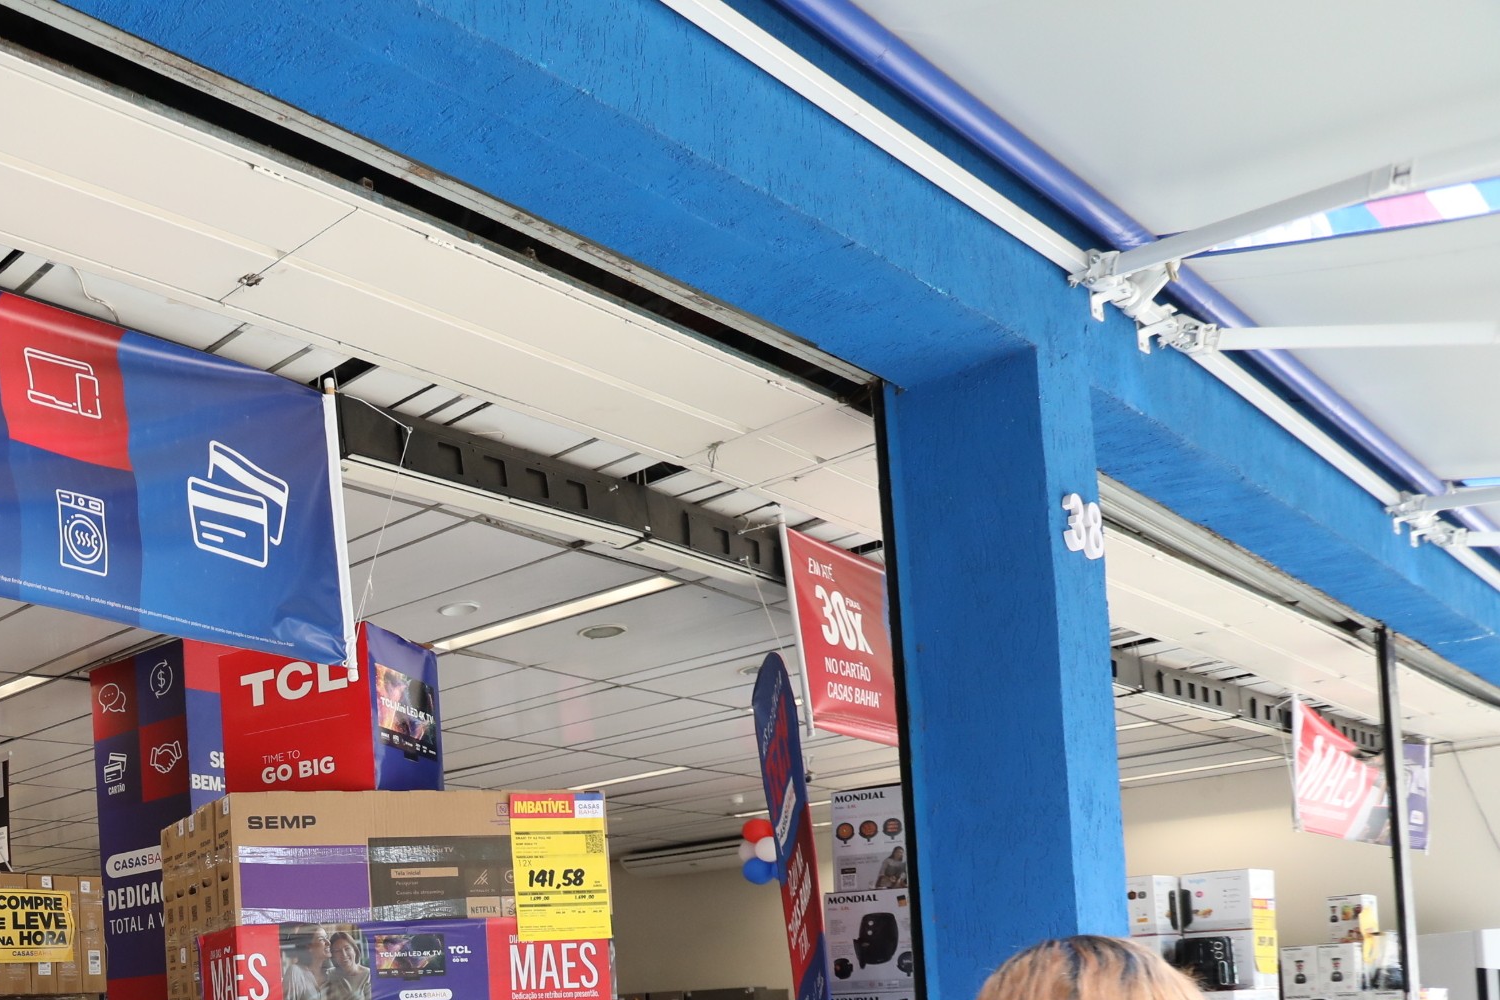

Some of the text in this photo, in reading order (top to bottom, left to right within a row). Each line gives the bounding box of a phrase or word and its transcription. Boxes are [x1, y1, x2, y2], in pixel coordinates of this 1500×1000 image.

[1062, 493, 1104, 560] 38
[808, 557, 835, 582] EM ATÉ
[825, 656, 871, 682] NO CARTÃO
[240, 660, 349, 707] TCL
[827, 681, 853, 703] CASAS
[380, 697, 395, 709] TCL
[406, 706, 418, 719] LED
[418, 710, 426, 721] 4K
[426, 713, 435, 725] TV
[262, 749, 300, 765] TIME TO
[261, 756, 335, 784] GO BIG
[108, 783, 126, 796] CARTÃO
[834, 789, 885, 803] MONDIAL
[514, 798, 573, 814] IMBATÍVEL
[247, 815, 317, 830] SEMP
[114, 853, 162, 872] CASASBA
[528, 868, 585, 889] 141,58
[108, 881, 164, 912] DEDICA
[828, 893, 879, 904] MONDIAL
[470, 905, 497, 914] NETFLIX
[12, 912, 67, 930] LEVE
[109, 915, 156, 936] TOTAL A
[19, 930, 67, 946] HORA
[448, 945, 471, 954] TCL
